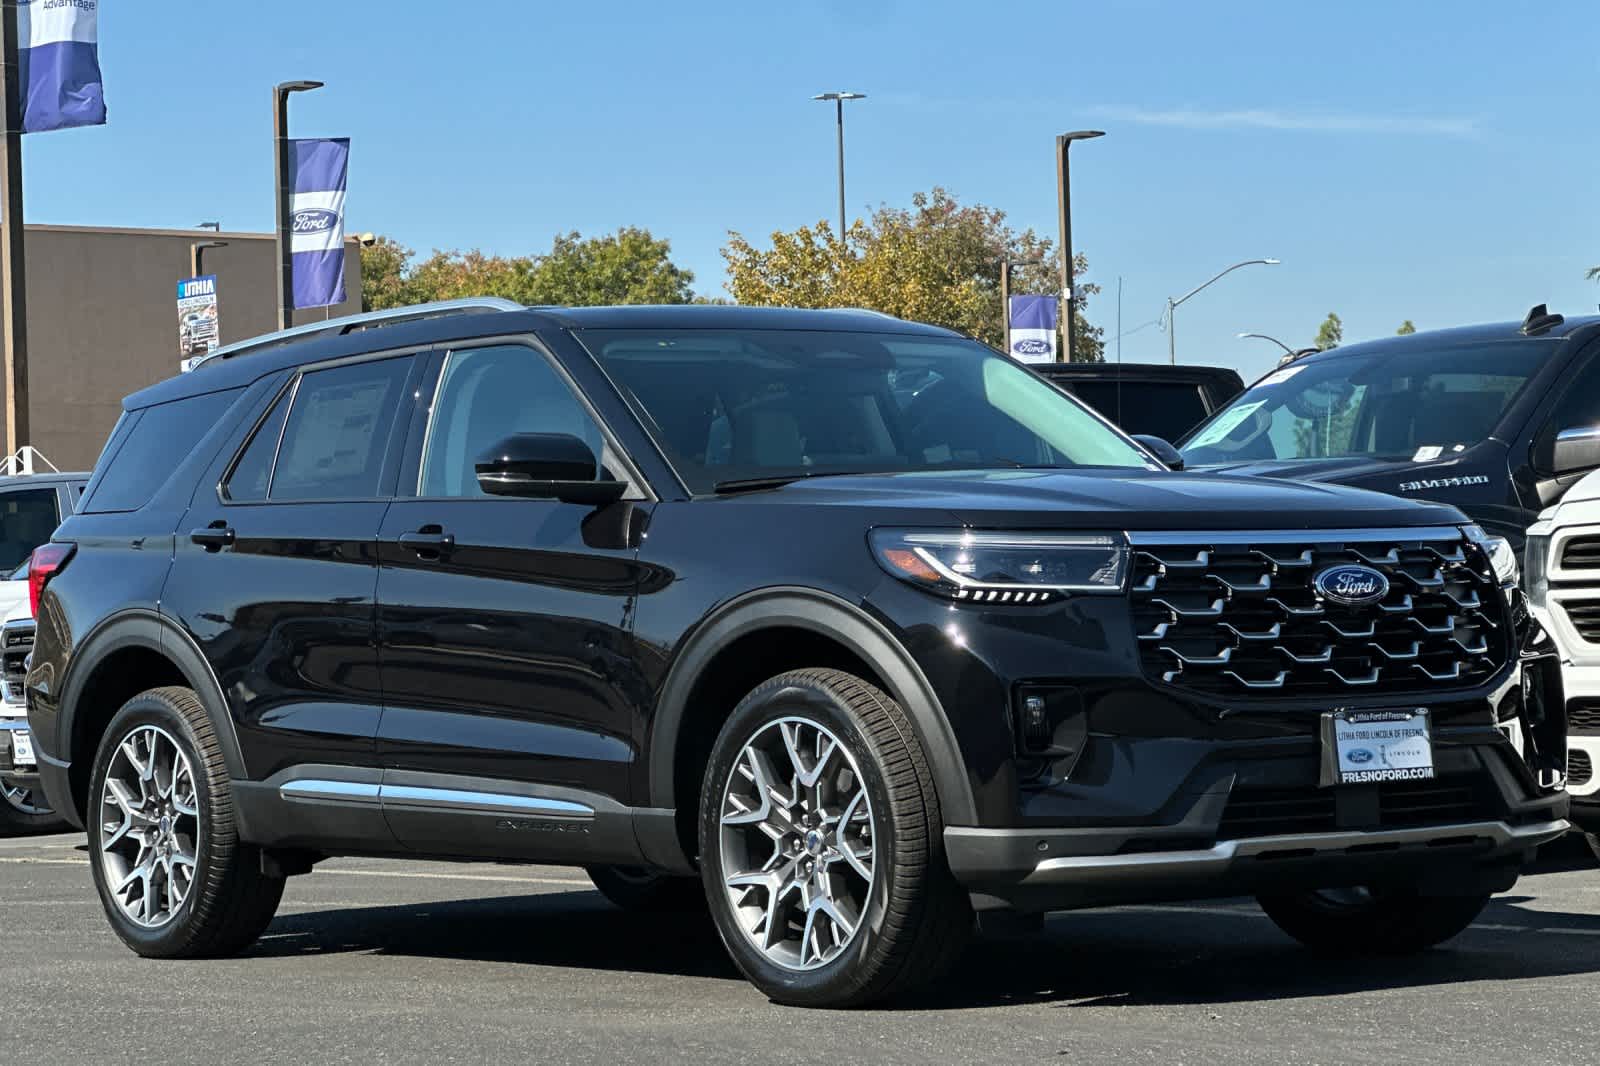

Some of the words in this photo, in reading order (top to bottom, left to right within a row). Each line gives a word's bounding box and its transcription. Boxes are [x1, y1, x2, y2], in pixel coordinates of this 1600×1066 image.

[293, 212, 329, 231] Ford
[184, 279, 214, 297] LITHIA
[1019, 340, 1047, 353] Ford
[1336, 572, 1377, 594] Ford
[1369, 712, 1381, 720] Ford
[1355, 730, 1370, 740] FORD
[1371, 728, 1394, 739] LINCOLN
[1402, 727, 1424, 738] FRESNO
[1342, 767, 1434, 783] FRESNOFORD.COM
